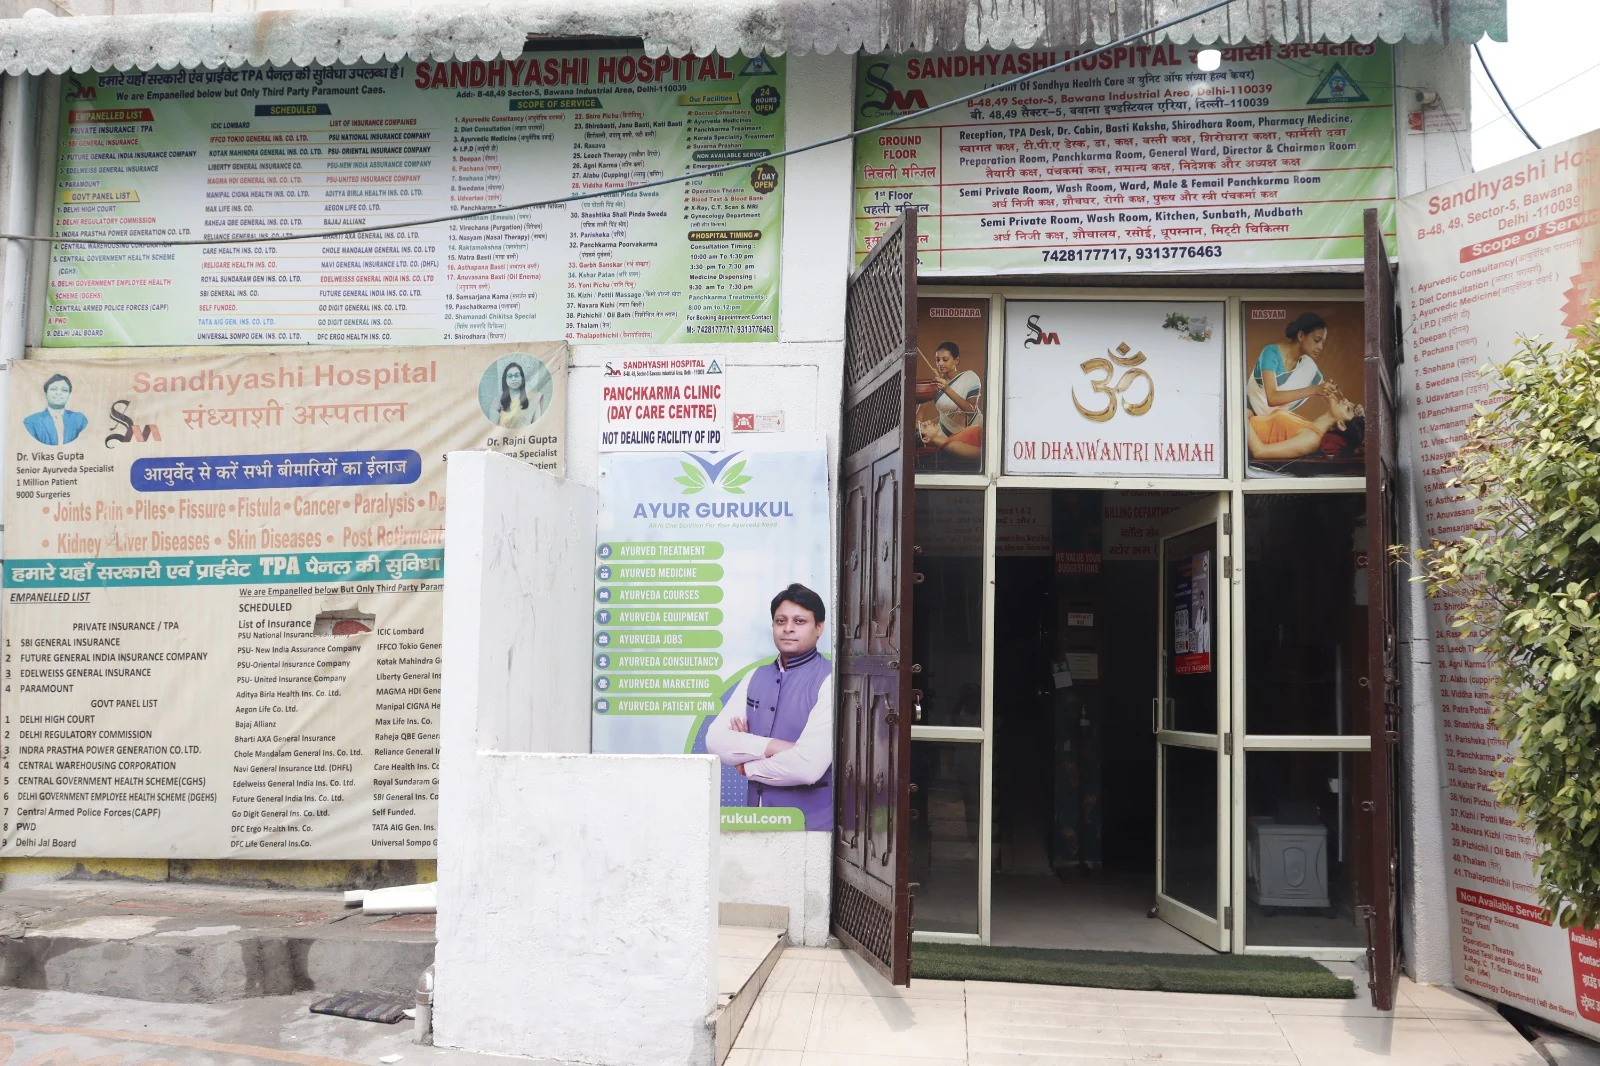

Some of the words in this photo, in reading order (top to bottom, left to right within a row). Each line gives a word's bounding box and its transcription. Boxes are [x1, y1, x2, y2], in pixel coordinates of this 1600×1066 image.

[907, 52, 1057, 80] SANDHYASHI
[1065, 44, 1181, 71] HOSPITAL
[415, 58, 589, 90] SANDHYASHI
[598, 52, 733, 83] HOSPITAL
[1021, 82, 1030, 90] Of
[1033, 80, 1069, 91] Sandhya
[1073, 78, 1100, 88] Health
[1104, 77, 1124, 86] Care
[508, 89, 542, 97] Sector-5,
[760, 88, 770, 96] 24
[967, 97, 1008, 108] B-48,49
[1012, 96, 1057, 106] Sector-5,
[1061, 94, 1105, 104] Bawana
[1108, 88, 1160, 100] Industrial
[1164, 87, 1194, 98] Area,
[1198, 84, 1272, 96] Delhi-110039
[271, 106, 317, 115] SCHEDULED
[959, 129, 1006, 141] Reception,
[1009, 128, 1026, 138] TPA
[1029, 127, 1054, 138] Desk,
[1057, 126, 1071, 136] Dr.
[1074, 124, 1102, 135] Cabin,
[1106, 119, 1130, 133] Basti
[1133, 118, 1169, 132] Kaksha,
[1172, 116, 1223, 130] Shirodhara
[1226, 116, 1255, 129] Room,
[1258, 116, 1305, 128] Pharmacy
[1308, 113, 1353, 126] Medicine,
[879, 136, 922, 146] GROUND
[883, 149, 917, 159] FLOOR
[757, 168, 763, 179] 7
[864, 163, 897, 181] निचली
[902, 163, 937, 180] मन्जिल
[755, 181, 773, 189] OPEN
[1428, 159, 1546, 215] Sandhyashi
[888, 190, 913, 201] Floor
[1156, 211, 1199, 221] Kitchen,
[1202, 209, 1251, 220] Sunbath,
[1255, 207, 1303, 217] Mudbath
[1418, 224, 1445, 240] B-48,
[1448, 218, 1463, 232] 49,
[1468, 200, 1519, 224] Sector-5,
[1524, 183, 1572, 207] Bawana
[1498, 212, 1529, 230] Delhi
[1472, 232, 1520, 256] Scope
[1525, 224, 1542, 241] of
[1042, 248, 1132, 262] 7428177717,
[1135, 245, 1222, 260] 9313776463
[930, 308, 981, 318] SHIRODHARA
[1252, 310, 1286, 319] NASYAM
[697, 325, 735, 334] 7428177717,
[737, 325, 774, 333] 9313776463
[623, 360, 668, 369] SANDHYASHI
[671, 360, 705, 368] HOSPITAL
[132, 365, 303, 397] Sandhyashi
[315, 361, 437, 390] Hospital
[604, 386, 680, 401] PANCHKARMA
[684, 385, 721, 399] CLINIC
[183, 400, 282, 431] संध्याशी
[292, 401, 408, 428] अस्पताल
[607, 406, 632, 423] (DAY
[636, 405, 665, 419] CARE
[668, 404, 716, 422] CENTRE)
[503, 436, 525, 447] Rajni
[529, 435, 557, 445] Gupta
[603, 432, 618, 444] NOT
[621, 431, 654, 444] DEALING
[658, 431, 692, 444] FACILITY
[695, 431, 705, 444] OF
[708, 431, 720, 444] IPD
[1012, 442, 1035, 460] OM
[1041, 438, 1150, 463] DHANWANTRI
[1154, 442, 1215, 463] NAMAH
[17, 452, 29, 461] Dr.
[32, 452, 54, 461] Vikas
[57, 452, 84, 462] Gupta
[17, 466, 40, 474] Senior
[42, 466, 77, 475] Ayurveda
[80, 465, 114, 475] Specialist
[144, 462, 194, 486] आयुर्वेद
[199, 461, 212, 480] से
[215, 461, 239, 479] करें
[243, 461, 273, 479] सभी
[277, 458, 339, 478] बीमारियों
[342, 462, 362, 475] का
[366, 456, 408, 478] ईलाज
[23, 478, 49, 486] Million
[36, 490, 70, 500] Surgeries
[54, 502, 92, 522] Joints
[135, 500, 167, 520] Piles
[179, 499, 225, 519] Fissure
[238, 496, 281, 517] Fistula
[294, 496, 340, 516] Cancer
[355, 493, 414, 518] Paralysis
[633, 503, 690, 519] AYUR
[695, 502, 793, 518] GURUKUL
[1105, 507, 1131, 519] BILLING
[621, 547, 656, 556] AYURVED
[659, 546, 705, 556] TREATMENT
[1056, 553, 1066, 562] WE
[1067, 553, 1084, 562] VALUE
[1086, 553, 1101, 562] YOUR
[620, 569, 656, 578] AYURVED
[658, 568, 697, 578] MEDICINE
[1058, 564, 1099, 573] SUGGESTIONS
[10, 593, 70, 602] EMPANELLED
[72, 592, 90, 602] LIST
[620, 590, 660, 600] AYURVEDA
[663, 590, 699, 599] COURSES
[620, 612, 660, 622] AYURVEDA
[663, 612, 709, 622] EQUIPMENT
[619, 635, 660, 644] AYURVEDA
[663, 634, 682, 644] JOBS
[619, 657, 660, 666] AYURVEDA
[662, 656, 719, 666] CONSULTANCY
[619, 679, 660, 689] AYURVEDA
[662, 679, 709, 689] MARKETING
[91, 700, 114, 708] GOVT
[116, 700, 140, 708] PANEL
[142, 699, 157, 708] LIST
[619, 701, 660, 711] AYURVEDA
[662, 701, 695, 711] PATIENT
[697, 701, 715, 711] CRM
[17, 823, 36, 831] PWD
[1461, 892, 1476, 902] Non
[1480, 896, 1514, 912] Available
[1461, 907, 1492, 923] Emergency
[1495, 916, 1519, 929] Services
[1462, 927, 1472, 935] ICU
